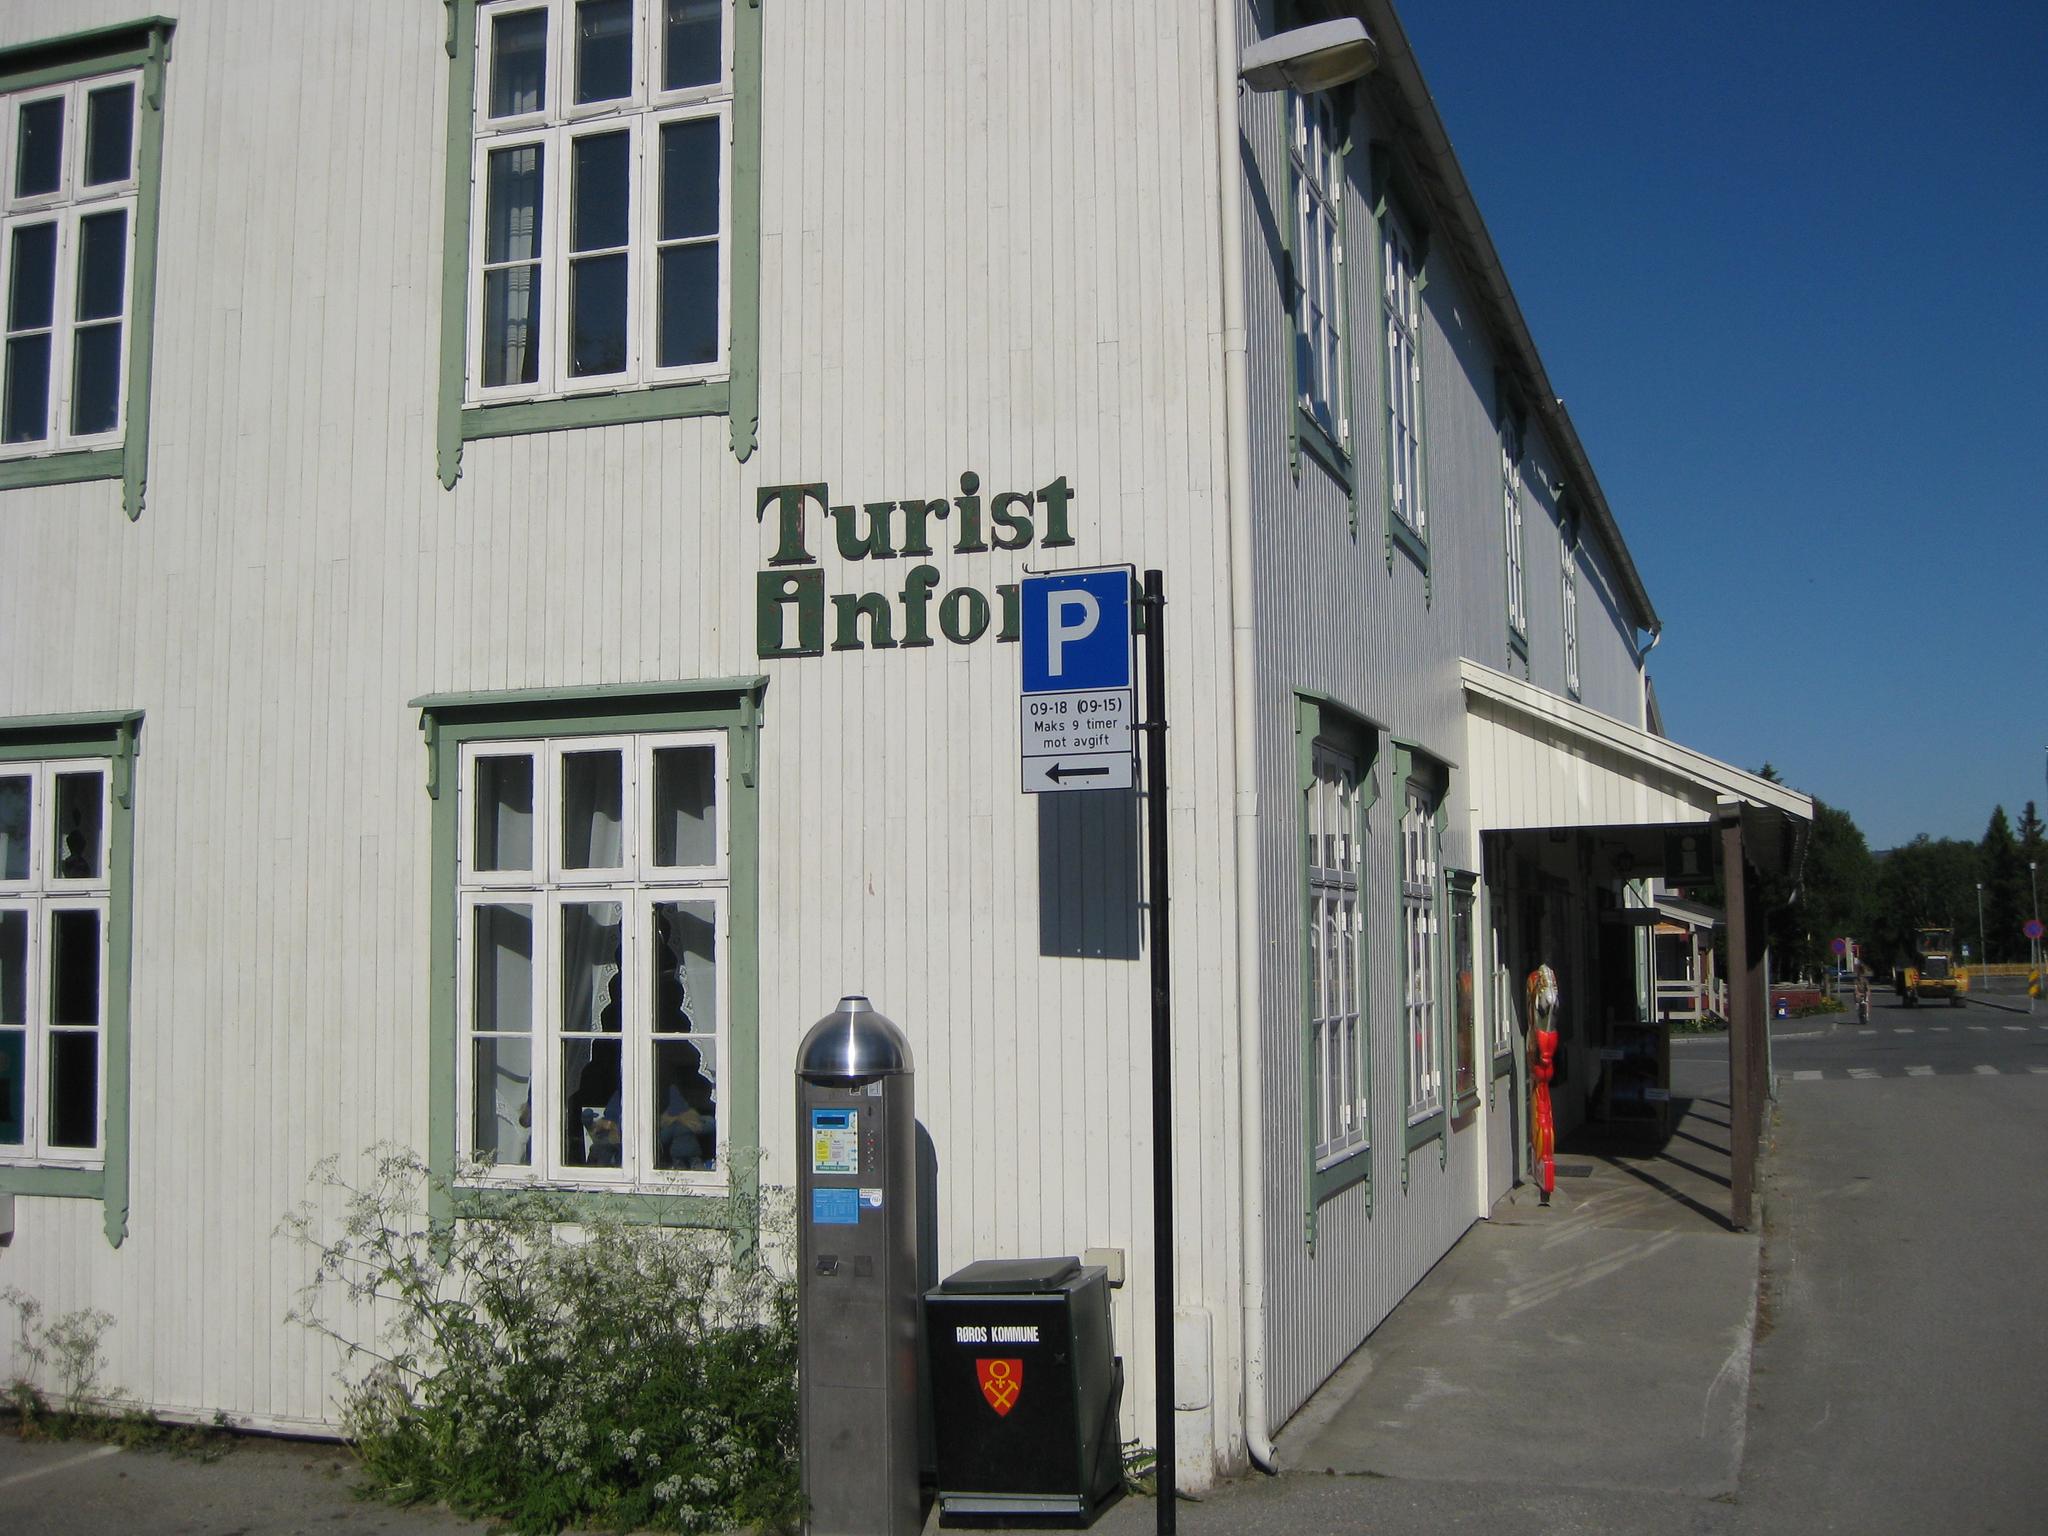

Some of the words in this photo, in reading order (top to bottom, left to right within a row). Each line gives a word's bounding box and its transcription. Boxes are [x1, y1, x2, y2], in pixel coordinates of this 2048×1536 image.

[757, 471, 1075, 566] Turist
[1048, 589, 1100, 677] P
[1030, 701, 1067, 715] 09-18
[1077, 697, 1122, 714] (09-15)
[1034, 720, 1065, 732] Maks
[1072, 720, 1079, 730] 9
[1087, 718, 1117, 730] timer
[1043, 736, 1067, 748] mot
[1073, 734, 1109, 749] avgift
[956, 1326, 988, 1342] RØROS
[991, 1326, 1040, 1342] KOMMUNE
